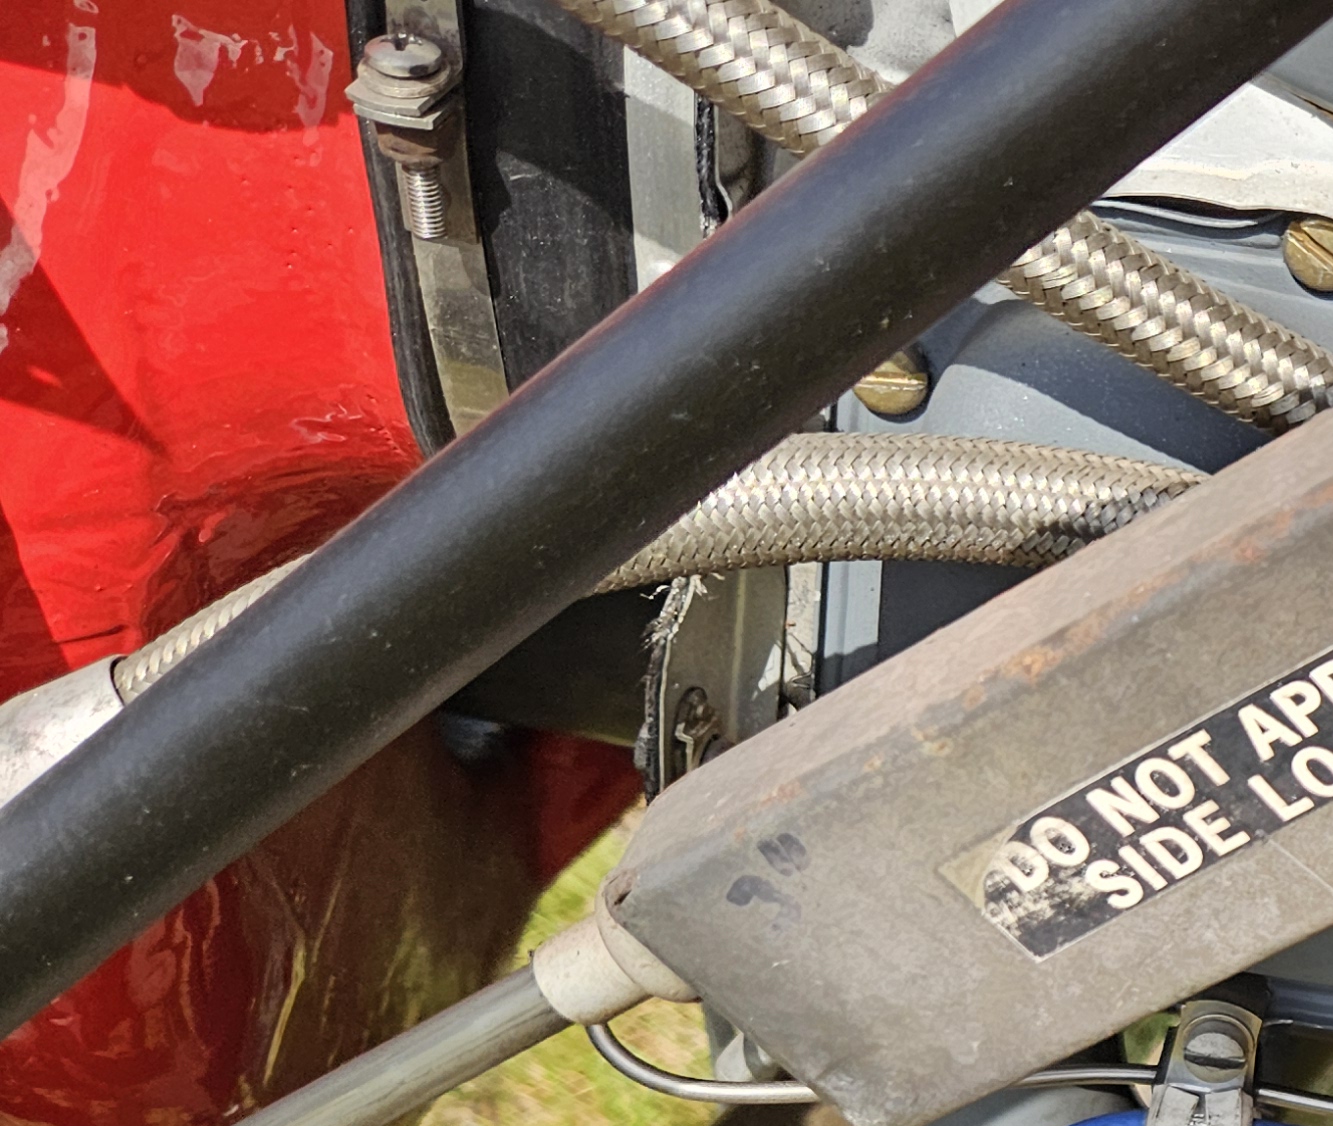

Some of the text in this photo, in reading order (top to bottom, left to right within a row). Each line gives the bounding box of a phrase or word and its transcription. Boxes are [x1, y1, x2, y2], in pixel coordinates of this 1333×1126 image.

[998, 815, 1090, 894] DO
[1085, 730, 1230, 838] NOT
[1084, 799, 1251, 910] SIDE
